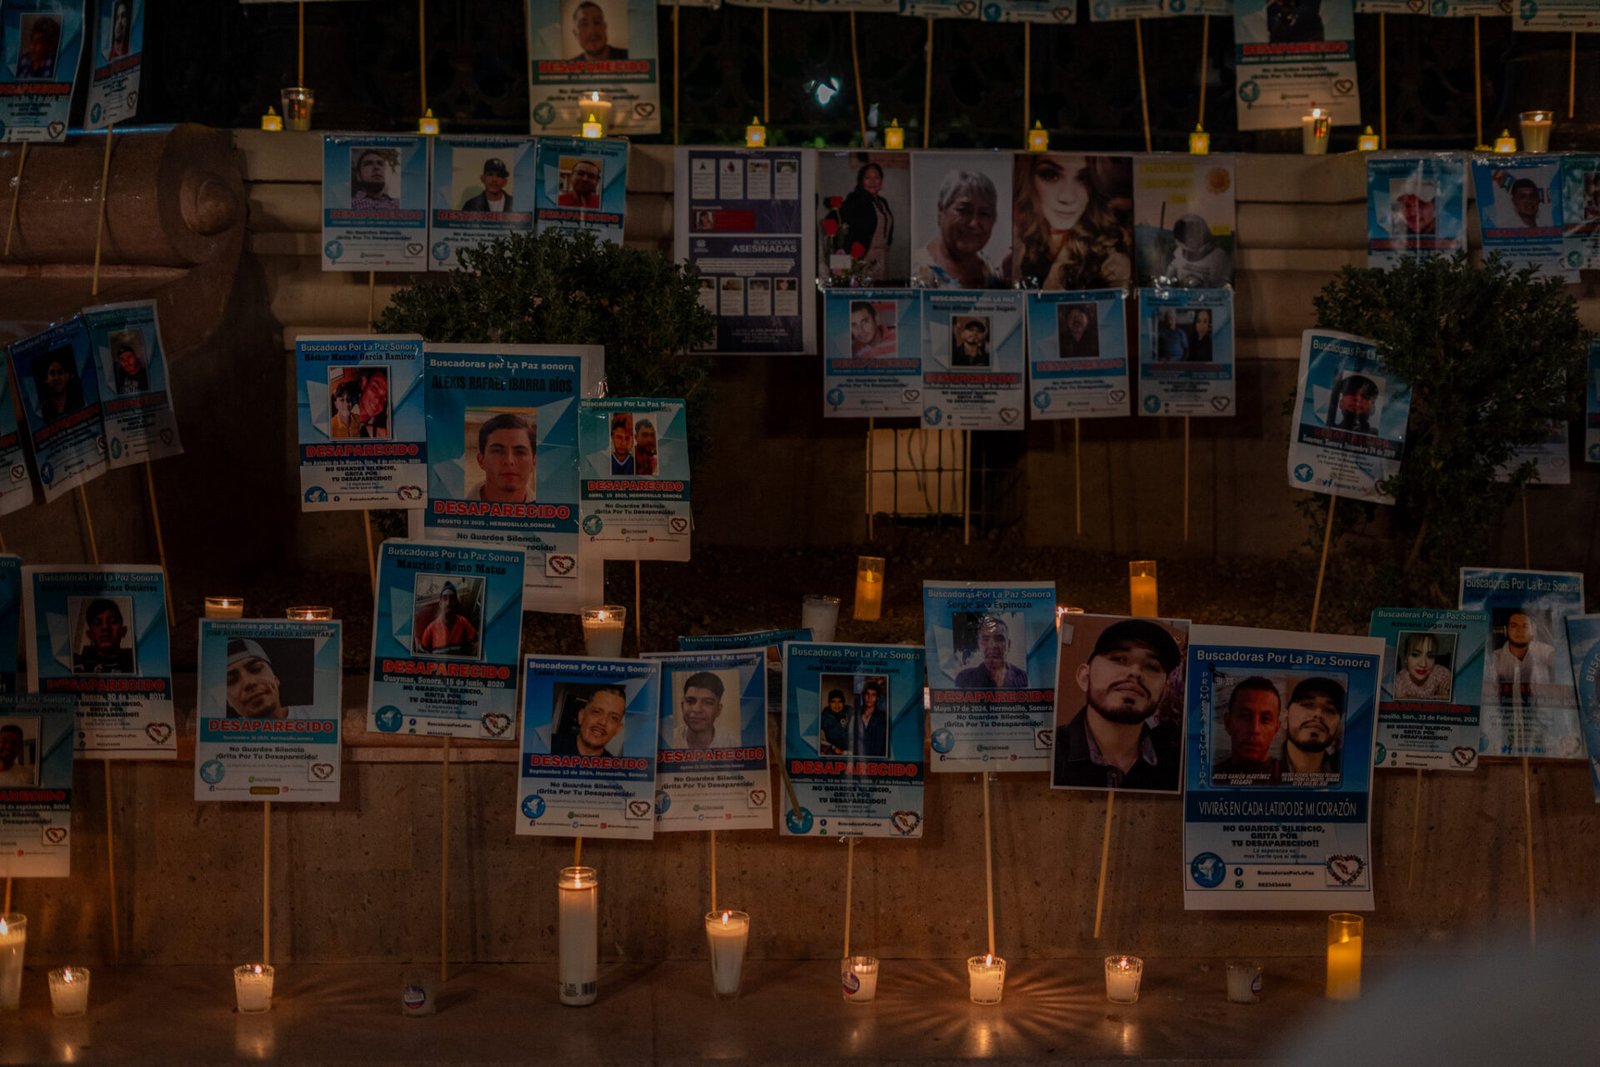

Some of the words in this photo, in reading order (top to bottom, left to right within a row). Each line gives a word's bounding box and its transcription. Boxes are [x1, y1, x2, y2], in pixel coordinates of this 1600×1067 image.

[731, 244, 797, 253] ASESINADAS
[301, 343, 348, 352] Buscadoras
[348, 343, 361, 352] Por
[364, 343, 373, 351] La
[374, 343, 388, 351] Paz
[391, 343, 418, 351] Sonora
[430, 358, 486, 369] Buscadoras
[488, 361, 505, 370] por
[507, 361, 519, 369] La
[521, 361, 539, 370] Paz
[541, 362, 575, 371] sonora
[432, 375, 466, 390] ALEXIS
[469, 376, 504, 391] RAFAEL
[508, 376, 545, 392] IBARRA
[549, 376, 573, 393] RÍOS
[305, 444, 419, 457] DESAPARECIDO
[587, 480, 684, 492] DESAPARECIDO
[434, 500, 570, 519] DESAPARECIDO
[470, 533, 504, 542] Guardes
[507, 535, 541, 543] Silencio
[387, 547, 440, 558] Buscadoras
[441, 549, 456, 558] Por
[458, 550, 469, 559] La
[471, 551, 487, 560] Paz
[488, 553, 519, 563] Sonora
[396, 559, 441, 571] Mauricio
[444, 561, 472, 572] Romo
[475, 563, 506, 574] Matus
[1466, 576, 1510, 589] Buscadoras
[1511, 577, 1525, 590] Por
[1527, 578, 1537, 590] La
[1537, 579, 1551, 591] Paz
[928, 588, 976, 598] Buscadoras
[977, 590, 992, 598] Por
[992, 590, 1003, 598] La
[1004, 590, 1019, 598] Paz
[1021, 591, 1051, 599] Sonora
[994, 600, 1032, 611] Espinoza
[1378, 610, 1421, 618] Buscadoras
[1421, 611, 1435, 619] Por
[1446, 612, 1459, 620] Paz
[1460, 612, 1487, 621] Sonora
[1444, 622, 1467, 630] Rivera
[791, 646, 842, 657] Buscadoras
[844, 648, 858, 657] Por
[860, 649, 871, 658] La
[872, 649, 888, 659] Paz
[890, 650, 920, 660] Sonora
[1197, 650, 1264, 662] Buscadoras
[1267, 652, 1286, 663] Por
[1289, 653, 1303, 664] La
[1305, 654, 1326, 666] Paz
[1329, 656, 1371, 669] Sonora
[382, 659, 511, 679] DESAPARECIDO
[529, 661, 579, 670] Buscadoras
[581, 663, 595, 671] Por
[610, 664, 625, 672] Paz
[627, 665, 656, 673] Sonora
[383, 674, 416, 684] Guaymas,
[934, 690, 1054, 704] DESAPARECIDO
[989, 705, 1027, 713] Hermosillo,
[209, 720, 333, 732] DESAPARECIDO
[531, 755, 648, 770] DESAPARECIDO
[791, 760, 918, 777] DESAPARECIDO
[1199, 797, 1229, 816] VIVIRÁS
[1230, 801, 1241, 816] EN
[1242, 801, 1264, 816] CADA
[1264, 801, 1293, 816] LATIDO
[1294, 802, 1304, 816] DE
[1305, 802, 1315, 816] MI
[1315, 798, 1357, 817] CORAZÓN
[1282, 825, 1325, 833] SILENCIO,
